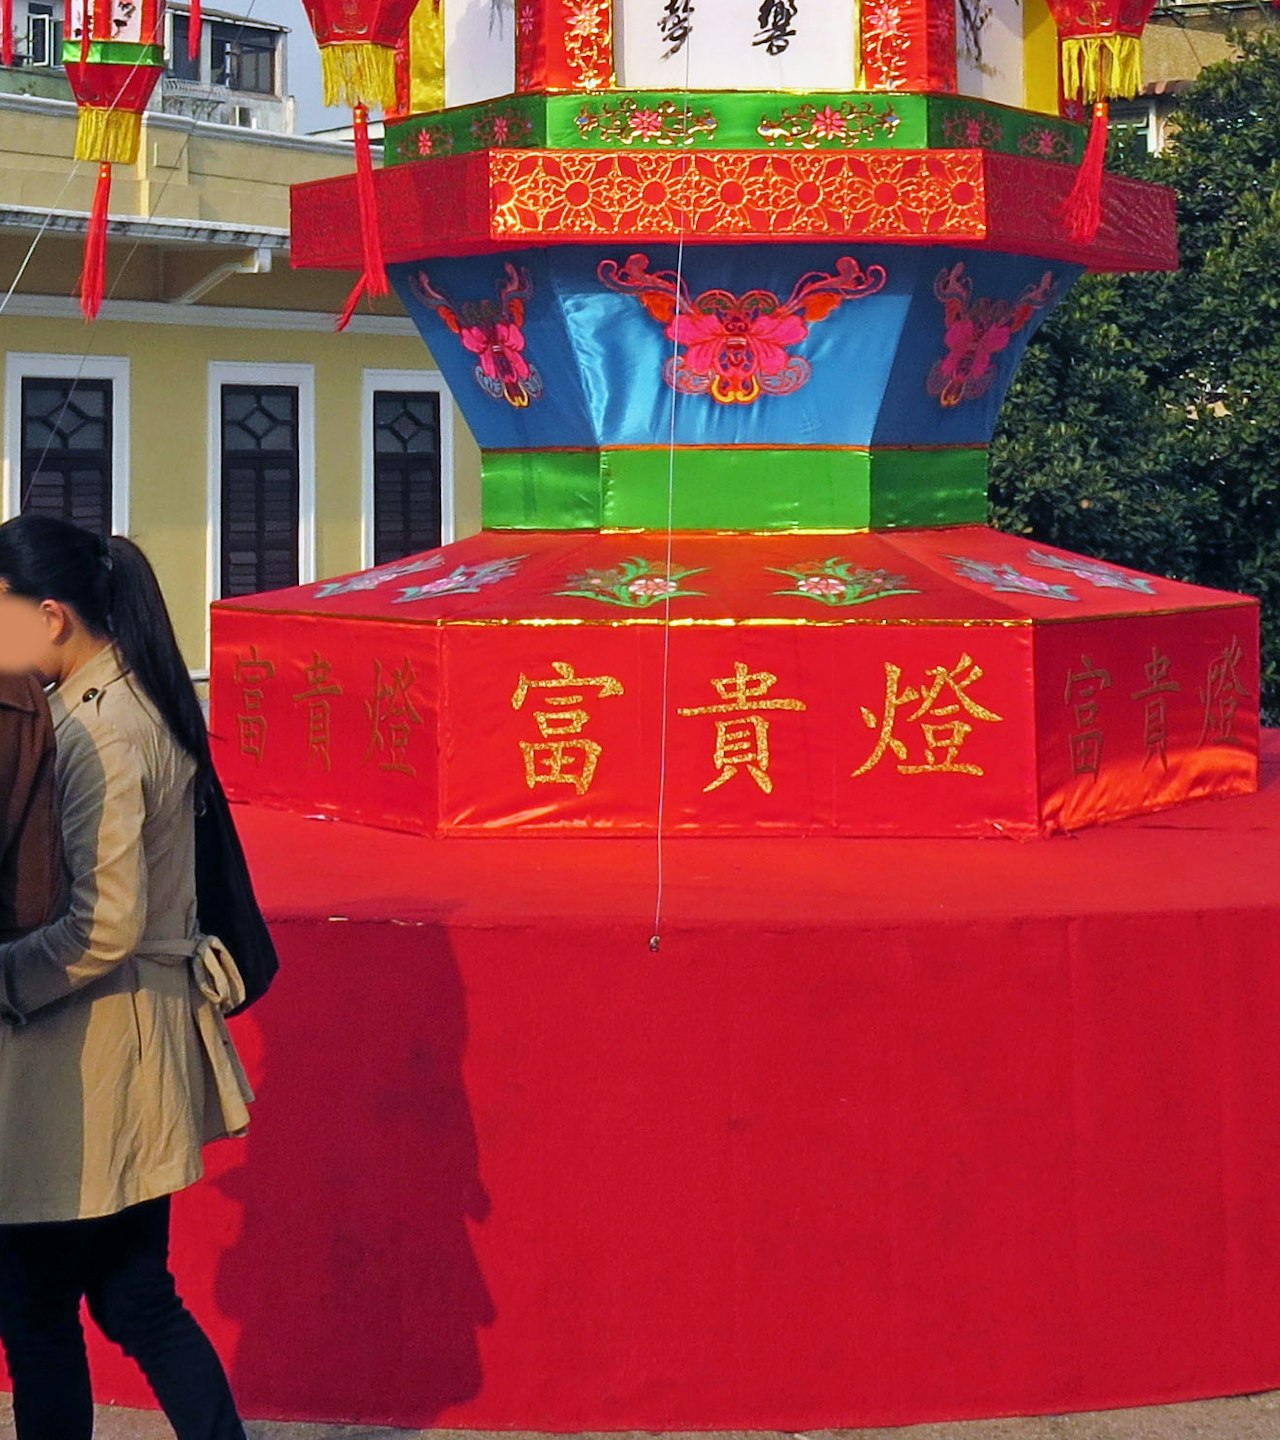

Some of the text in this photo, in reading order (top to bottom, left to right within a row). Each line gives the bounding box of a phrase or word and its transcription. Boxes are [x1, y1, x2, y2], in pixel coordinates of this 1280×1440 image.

[232, 644, 424, 778] 富貴燈
[510, 651, 1005, 796] 富貴燈
[1064, 634, 1252, 784] 富貴燈
